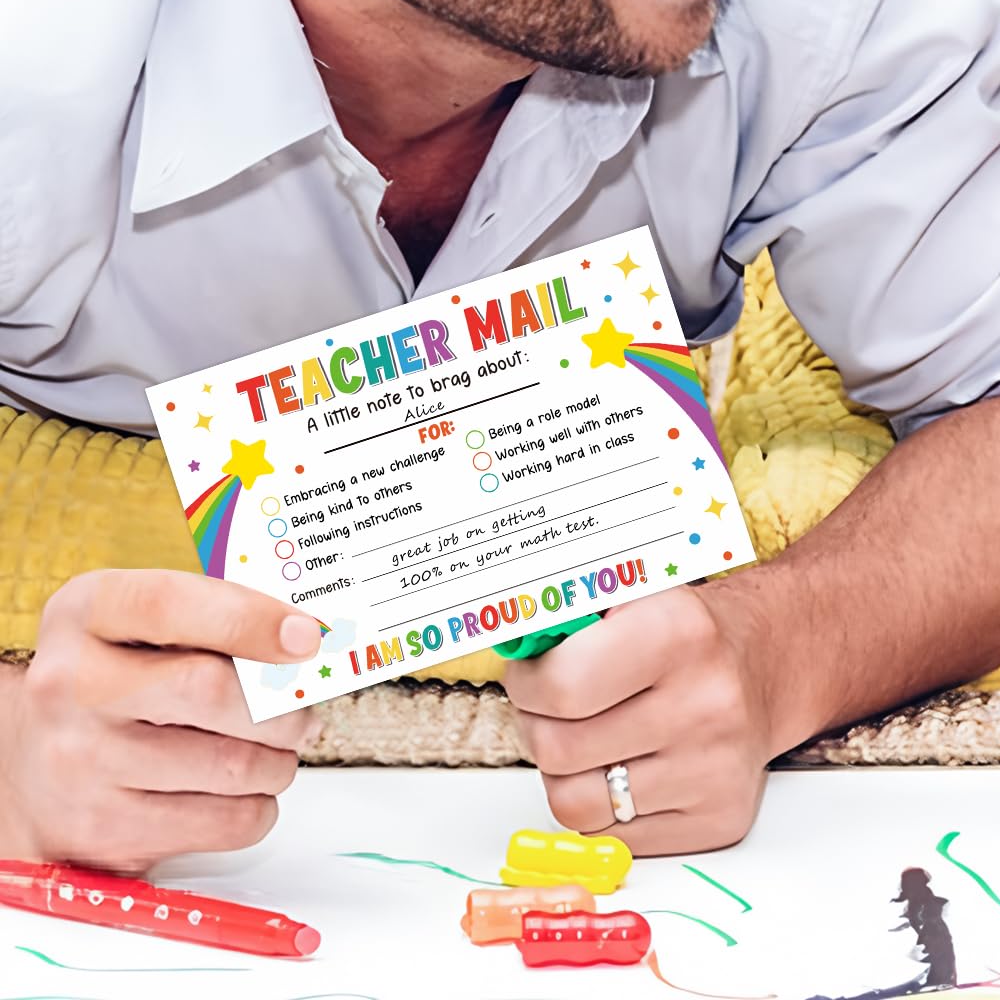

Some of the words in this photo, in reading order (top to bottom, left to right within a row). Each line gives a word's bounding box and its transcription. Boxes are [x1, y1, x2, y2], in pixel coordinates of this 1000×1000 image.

[235, 319, 457, 424] TEACHER
[463, 276, 588, 353] MAIL
[307, 417, 318, 433] A
[323, 405, 360, 427] little
[366, 392, 402, 413] note
[405, 385, 424, 399] to
[429, 370, 471, 392] brag
[477, 350, 529, 377] about:
[404, 401, 444, 422] Alice
[488, 422, 522, 439] Being
[526, 418, 534, 427] a
[537, 408, 561, 423] role
[565, 393, 600, 414] model
[417, 420, 455, 444] FOR:
[494, 438, 545, 460] Working
[548, 426, 571, 443] well
[575, 419, 600, 435] with
[604, 406, 643, 425] others
[283, 479, 346, 506] Embracing
[350, 475, 358, 485] a
[361, 466, 385, 480] new
[389, 447, 445, 471] challenge
[501, 460, 552, 482] Working
[555, 446, 585, 465] hard
[588, 443, 601, 454] in
[605, 433, 634, 449] class
[290, 510, 324, 528] Being
[327, 498, 353, 515] kind
[355, 495, 369, 506] to
[374, 481, 412, 500] others
[297, 526, 350, 549] Following
[353, 502, 422, 531] instructions
[392, 542, 431, 566] great
[438, 532, 458, 552] job
[466, 528, 485, 538] on
[492, 505, 545, 533] getting
[400, 566, 442, 588] 100%
[449, 561, 469, 572] on
[476, 544, 512, 566] your
[520, 526, 561, 549] math
[565, 515, 599, 533] test.
[305, 552, 344, 570] Other:
[291, 577, 355, 604] Comments:
[348, 650, 361, 676] I
[365, 636, 405, 671] AM
[405, 624, 443, 657] SO
[447, 594, 537, 643] PROUD
[540, 579, 576, 612] OF
[579, 558, 648, 600] YOU!
